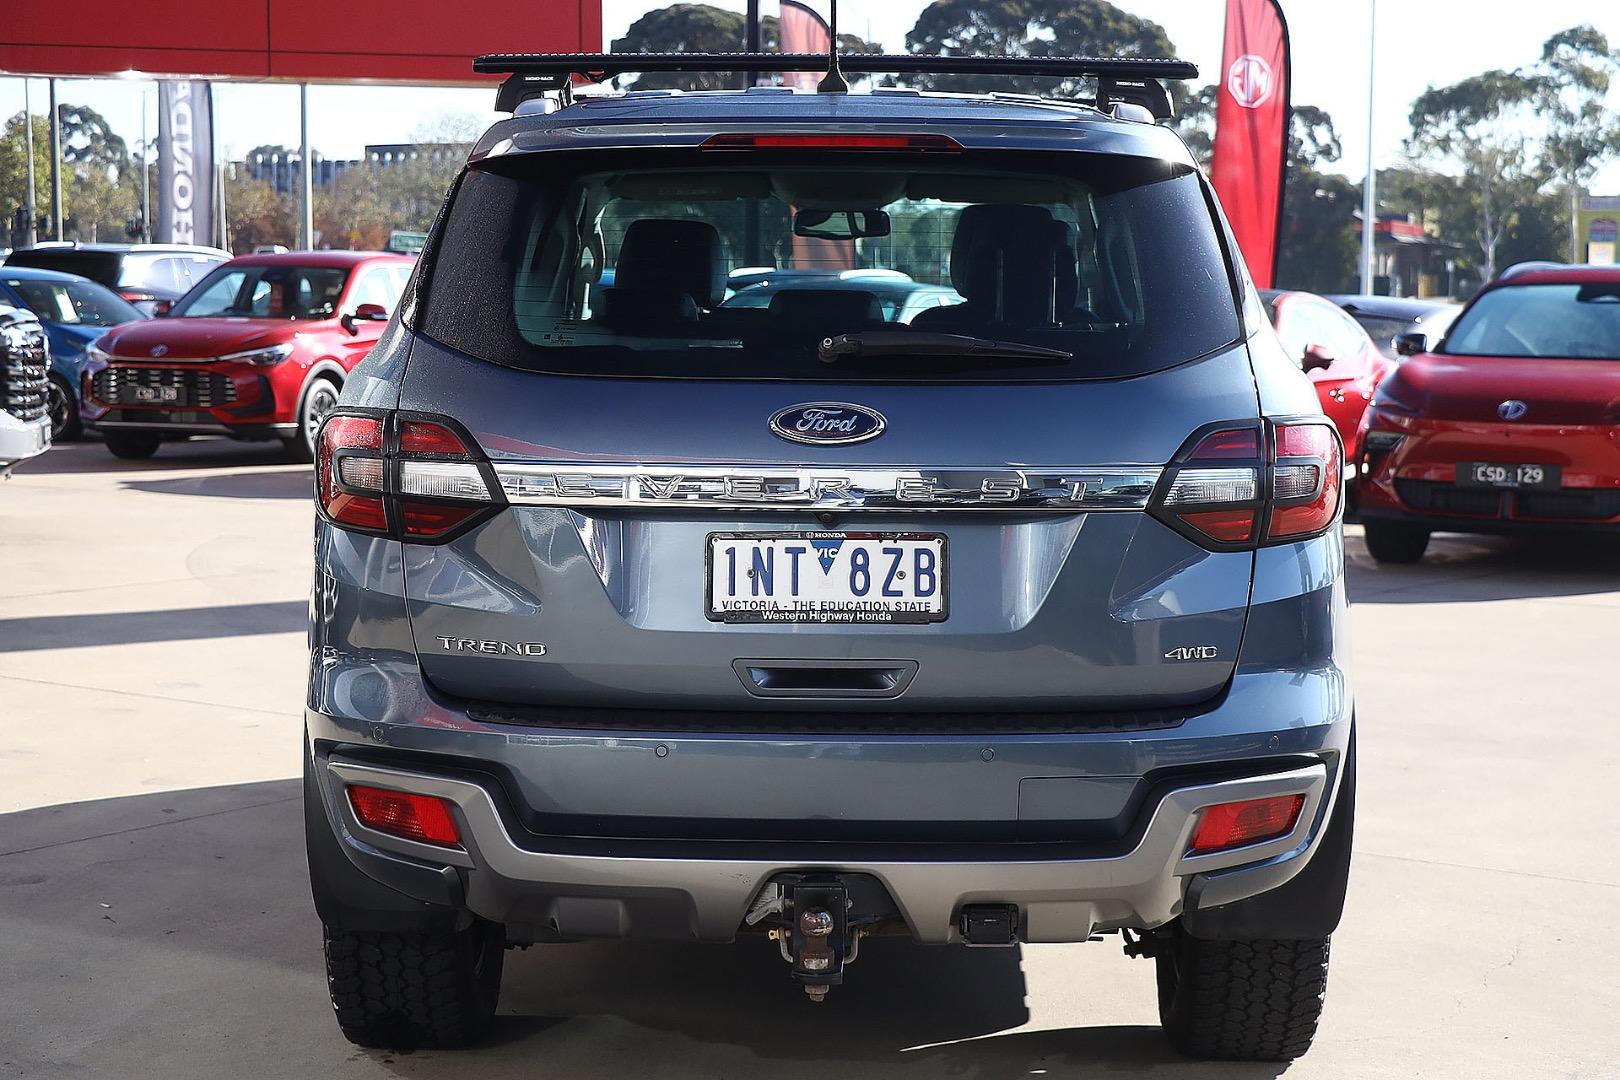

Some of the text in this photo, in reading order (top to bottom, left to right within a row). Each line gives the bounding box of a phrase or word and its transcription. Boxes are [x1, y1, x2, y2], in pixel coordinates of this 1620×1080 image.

[796, 408, 857, 432] Ford
[1476, 466, 1544, 483] CSD 129
[551, 472, 1104, 501] EVEREST
[817, 548, 838, 559] VIC
[725, 546, 936, 597] 1NT 8ZB
[722, 600, 779, 610] VICTORIA
[793, 600, 816, 611] THE
[821, 601, 890, 611] EDUCATION
[895, 602, 931, 612] STATE
[762, 610, 892, 622] Western Highway Honda
[435, 635, 547, 656] TREND
[1164, 646, 1218, 660] 4WD
